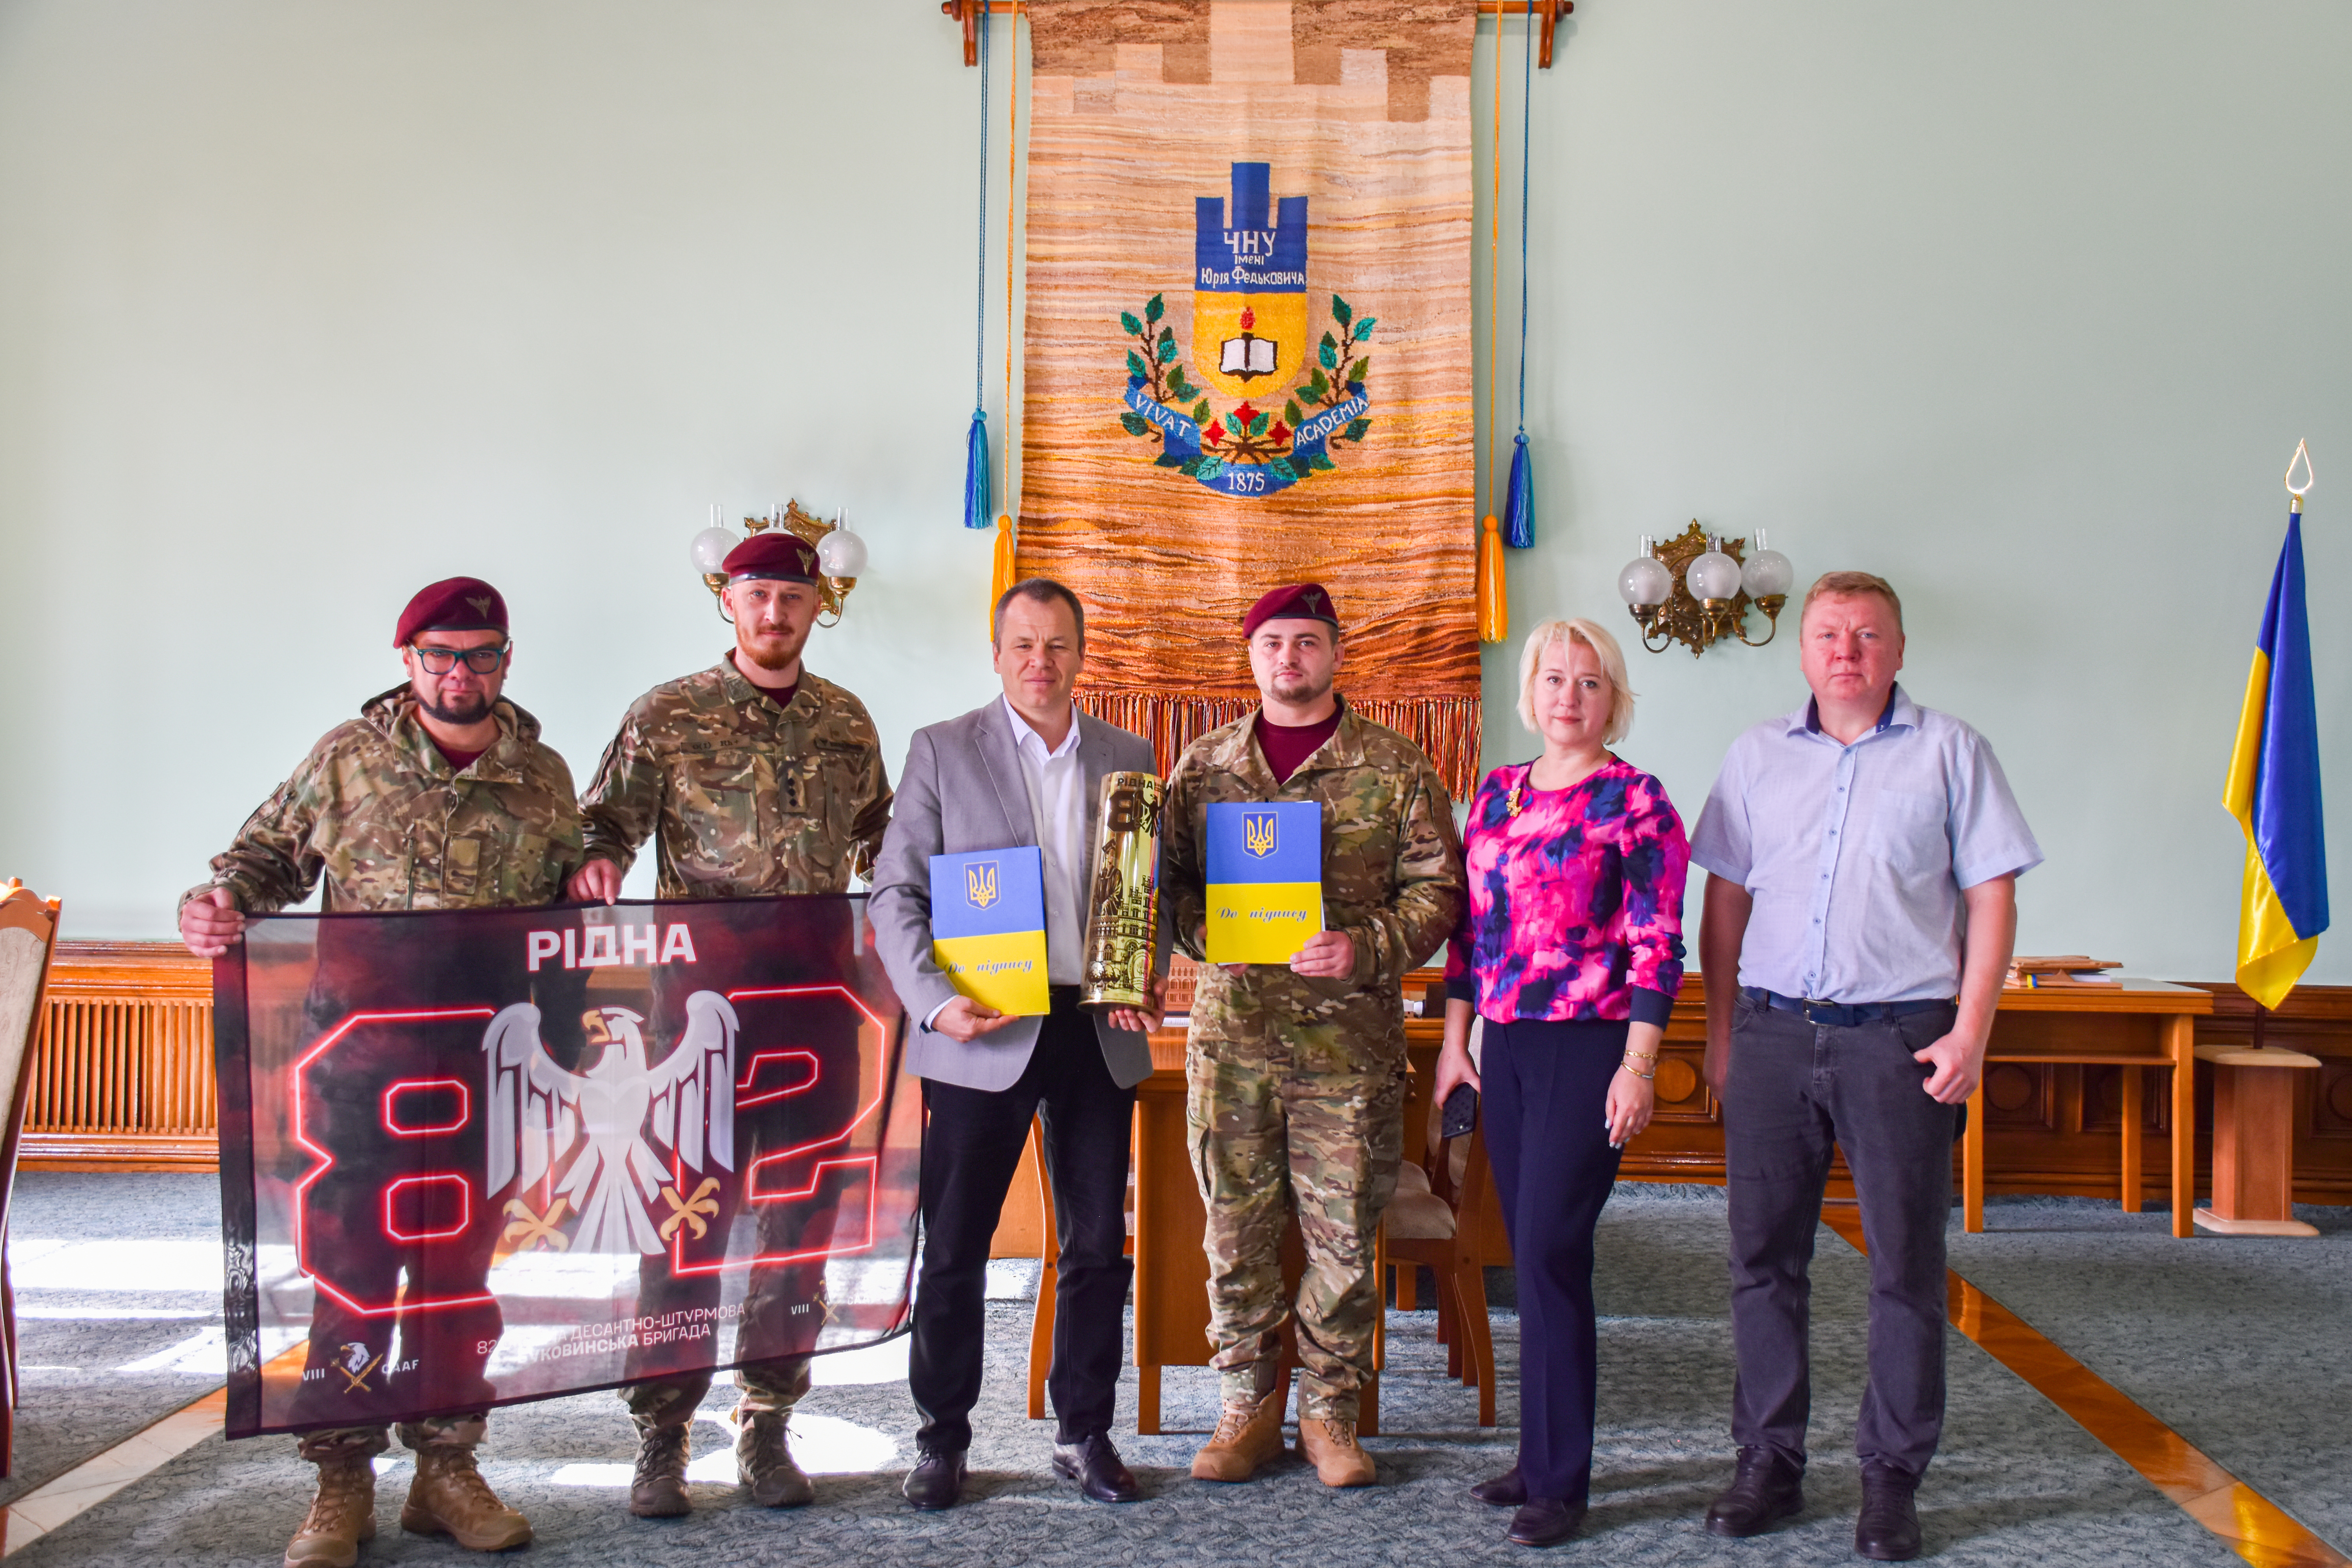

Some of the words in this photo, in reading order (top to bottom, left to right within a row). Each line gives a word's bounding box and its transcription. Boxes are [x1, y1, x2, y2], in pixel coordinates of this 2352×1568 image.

[1223, 230, 1276, 256] ЧНУ
[1201, 267, 1229, 289] Юрія
[1232, 265, 1305, 285] Федьковича
[1136, 394, 1191, 437] VIVAT
[1297, 397, 1368, 446] ACADEMIA
[1228, 472, 1265, 492] 1875
[1118, 778, 1153, 790] РІДНА
[1216, 906, 1237, 918] До
[1250, 906, 1307, 923] підпису
[528, 924, 697, 971] РІДНА
[944, 962, 965, 974] До
[977, 959, 1033, 975] підпису
[570, 1303, 745, 1341] ДЕСАНТНО-ШТУРМОВА
[791, 1304, 809, 1315] VIII
[518, 1334, 639, 1363] УКОВИНСЬКА
[643, 1323, 711, 1345] БРИГАДА
